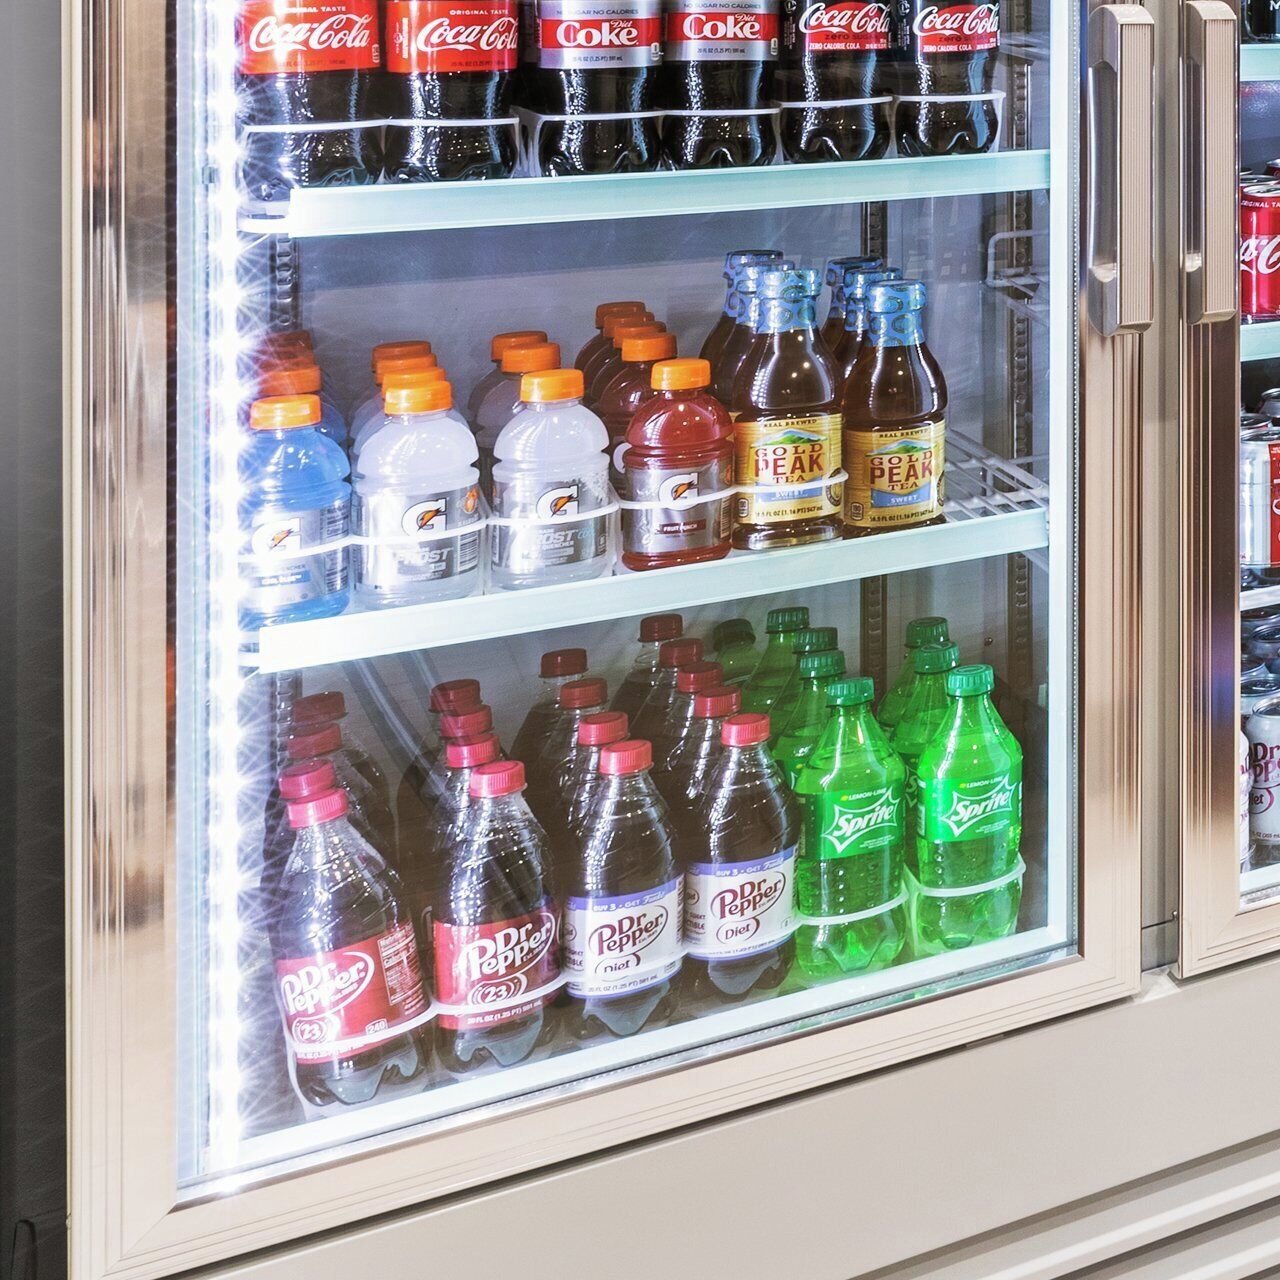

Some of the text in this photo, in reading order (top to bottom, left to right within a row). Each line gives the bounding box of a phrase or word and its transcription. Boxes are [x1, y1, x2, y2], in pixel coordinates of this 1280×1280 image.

[610, 20, 633, 28] Diet
[682, 14, 762, 39] Coke
[735, 13, 757, 22] Diet
[798, 2, 892, 34] Coca-Cola
[912, 2, 1000, 36] Coca-Cola
[249, 14, 373, 52] Coca-Cola
[416, 17, 519, 52] Coca-Cola
[556, 21, 640, 47] Coke
[755, 443, 824, 458] GOLD
[870, 450, 933, 466] GOLD
[754, 453, 824, 478] PEAK
[870, 460, 933, 485] PEAK
[658, 472, 700, 511] G
[773, 475, 806, 484] TEA
[888, 481, 919, 491] TEA
[890, 494, 918, 503] SWEET
[950, 791, 1010, 822] Sprite
[833, 805, 895, 837] Sprite
[746, 865, 761, 873] GET
[711, 879, 782, 920] Pepper
[740, 878, 767, 902] Dr
[609, 903, 617, 911] 3
[624, 900, 640, 908] GET
[590, 913, 664, 956] Pepper
[617, 913, 647, 937] Dr
[725, 923, 751, 940] Diet
[494, 922, 533, 955] Dr
[463, 922, 552, 981] Pepper
[281, 961, 366, 1016] Pepper
[298, 962, 337, 991] Dr
[484, 985, 507, 1004] 23
[301, 1024, 321, 1040] 23
[368, 1021, 386, 1034] 240
